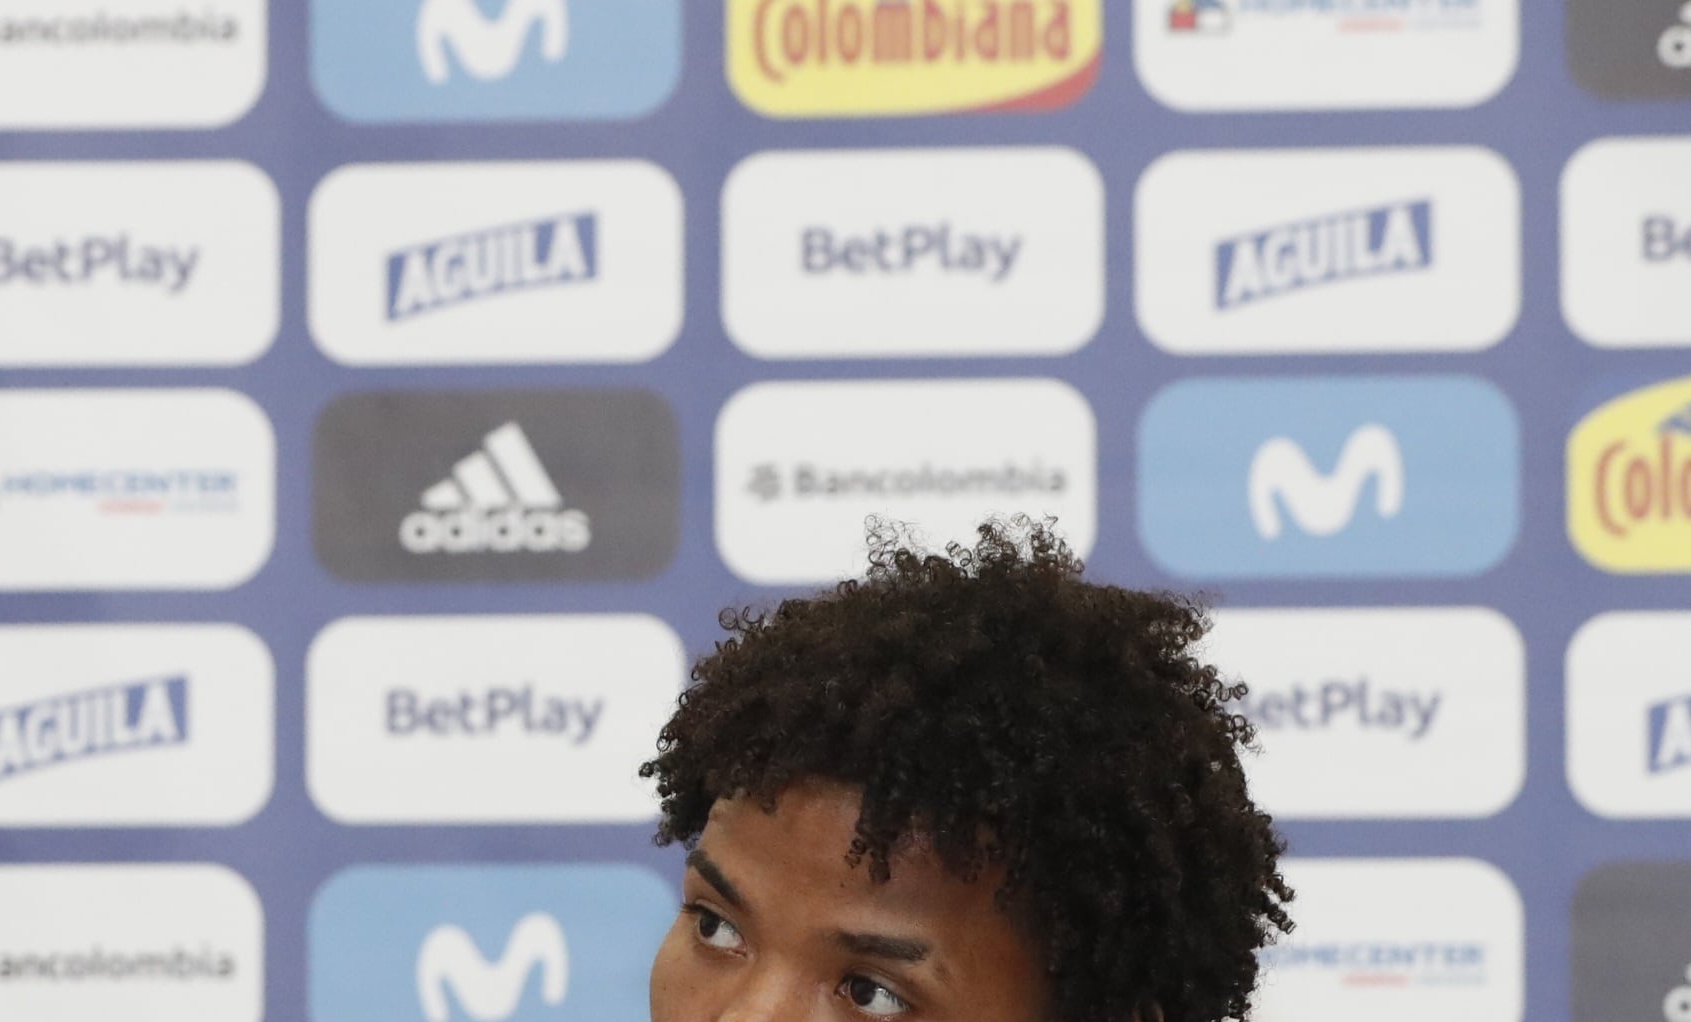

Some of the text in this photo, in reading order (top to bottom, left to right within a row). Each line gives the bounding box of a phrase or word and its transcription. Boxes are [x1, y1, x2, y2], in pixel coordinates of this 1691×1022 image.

[754, 0, 1071, 82] Colombiana
[390, 215, 592, 321] AGUILA
[801, 223, 1022, 281] BetPlay
[1218, 202, 1427, 307] AGUILA
[794, 460, 1067, 499] Bancolombia
[399, 506, 589, 553] adidas
[387, 685, 602, 746] BetPlay
[1235, 678, 1439, 741] etPlay
